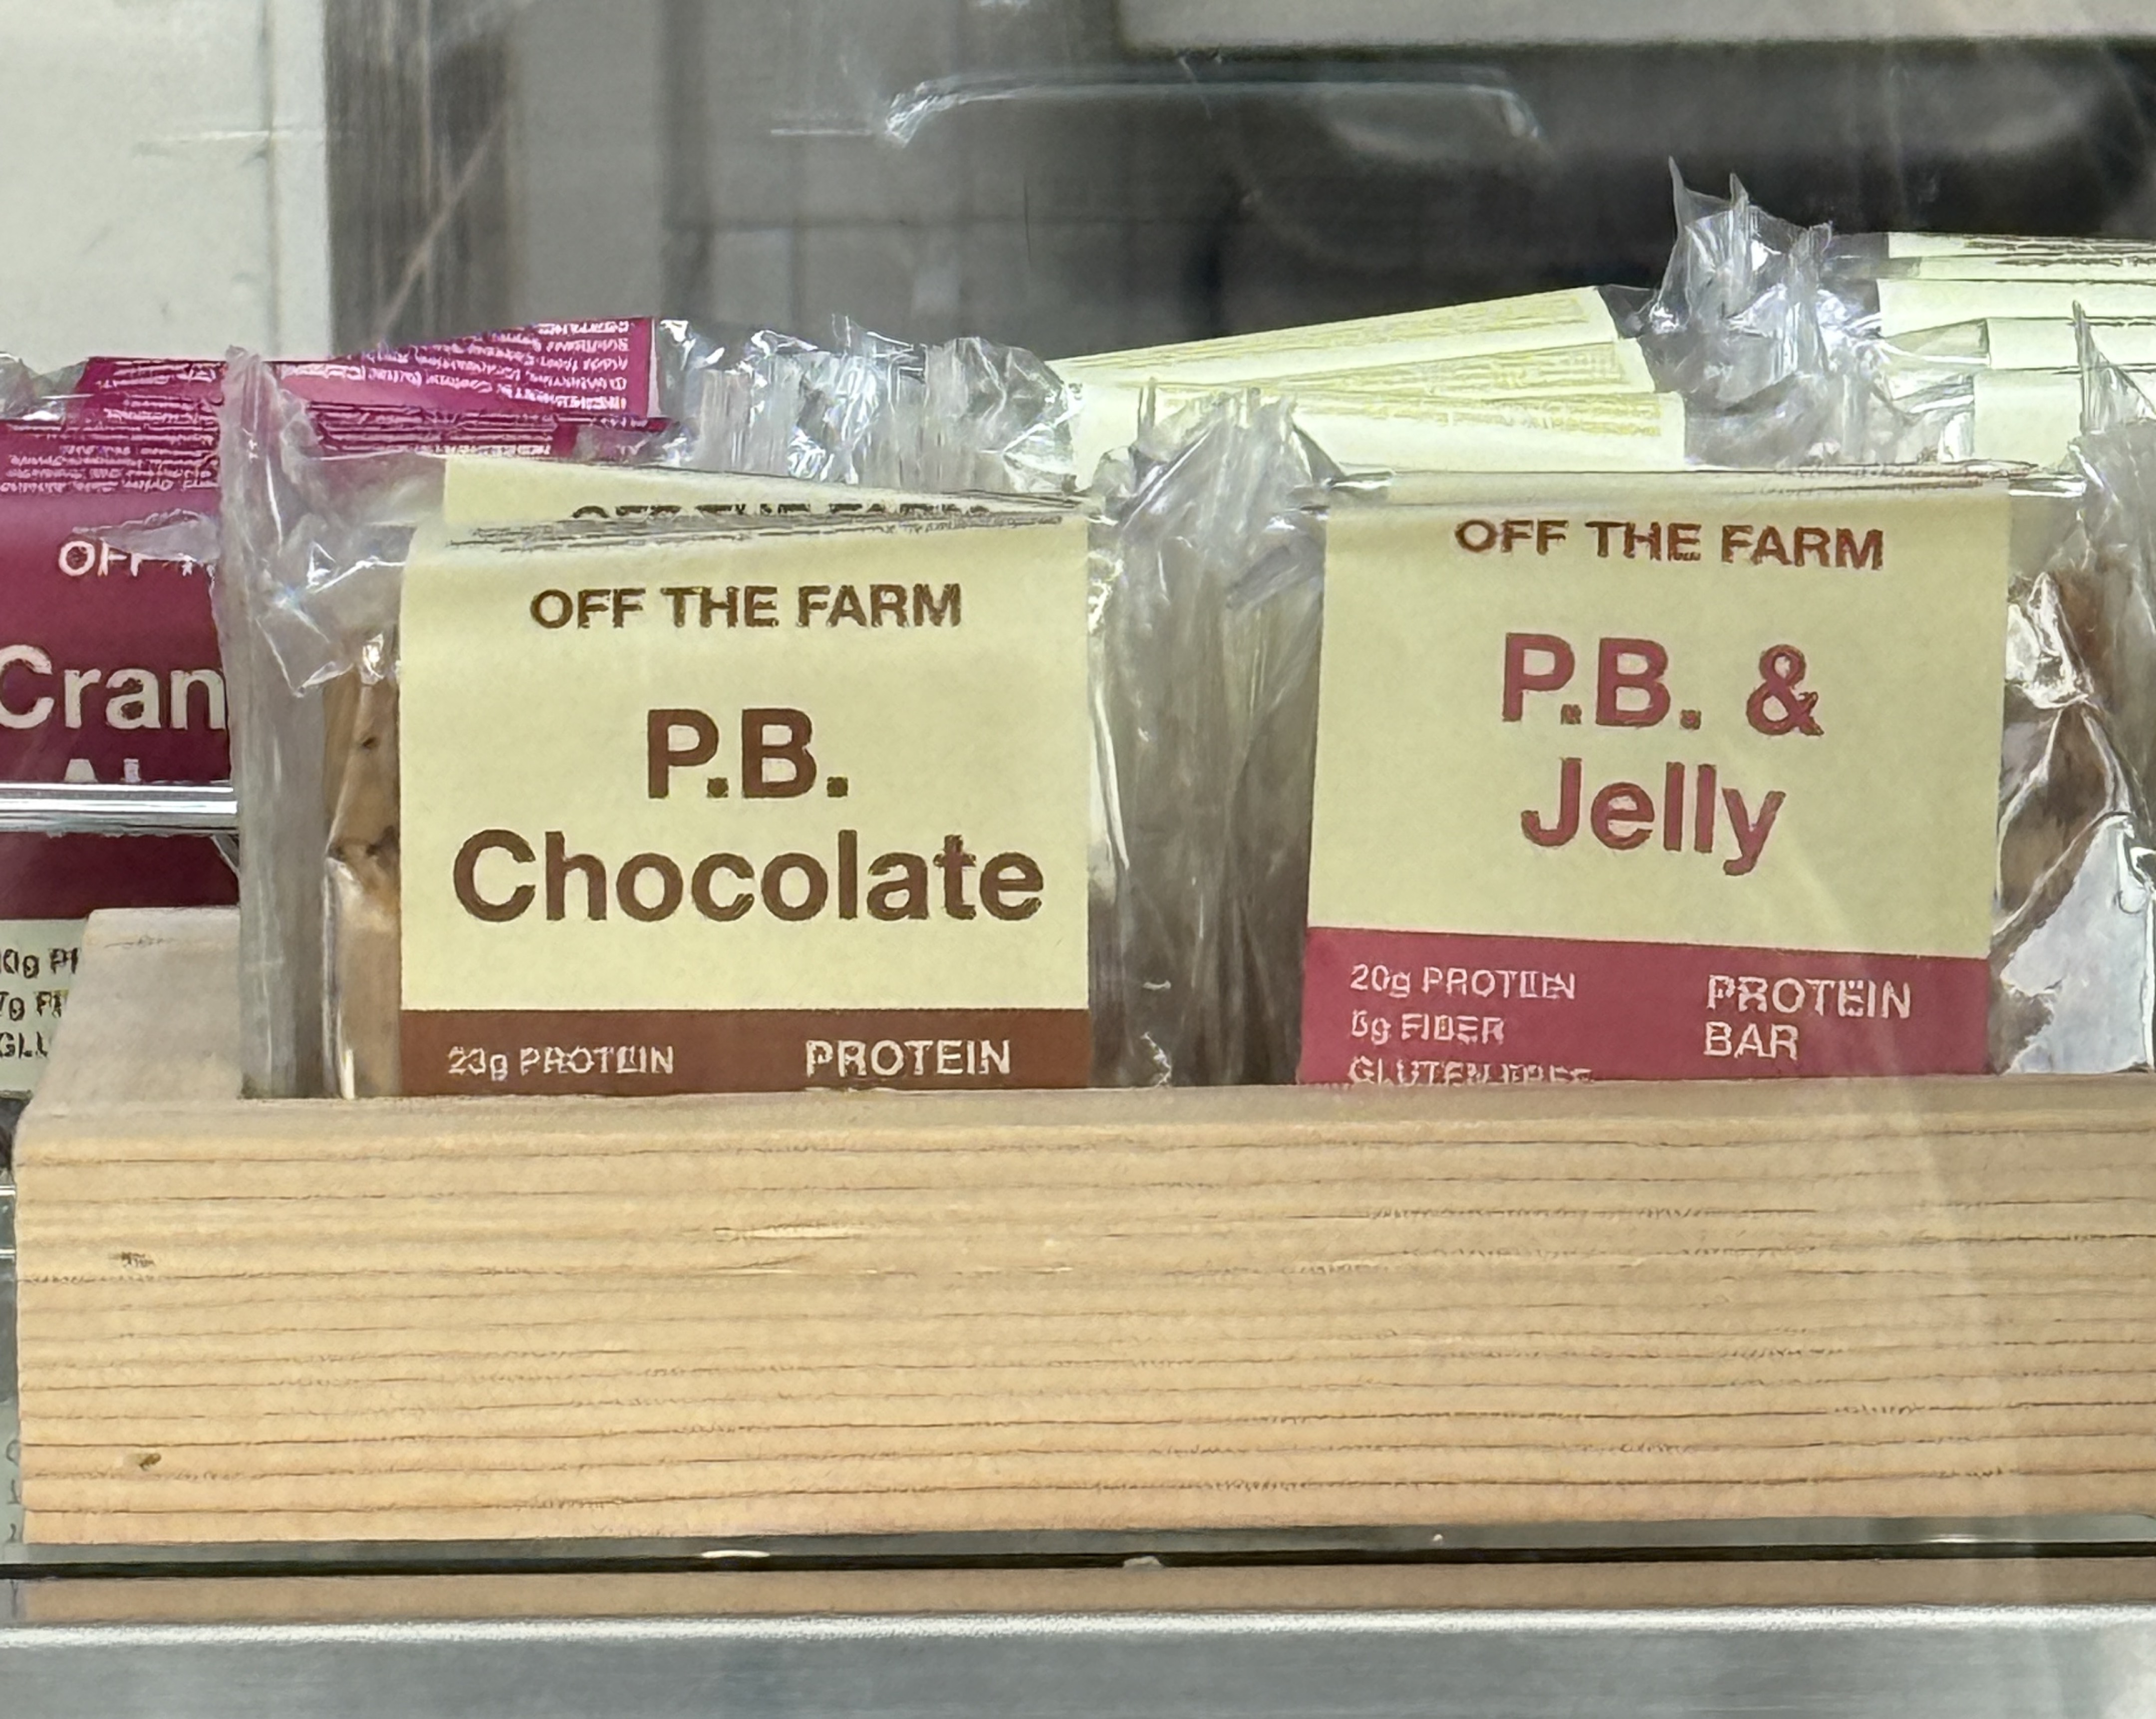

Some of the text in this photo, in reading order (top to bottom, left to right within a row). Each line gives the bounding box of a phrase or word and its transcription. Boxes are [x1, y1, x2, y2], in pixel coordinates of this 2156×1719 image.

[1454, 519, 1884, 571] OFF THE FARM
[530, 583, 962, 629] OFF THE FARM
[1502, 632, 1825, 737] P.B. &
[647, 708, 849, 799] P.B.
[1521, 757, 1787, 876] Jelly
[453, 829, 1045, 922] Chocolate
[1350, 963, 1576, 999] 20g PROTEIN
[1706, 974, 1911, 1019] PROTEIN
[1400, 1013, 1505, 1045] FIBER
[1703, 1021, 1799, 1060] BAR
[520, 1046, 674, 1077] PROTEIN
[806, 1040, 1011, 1078] PROTEIN
